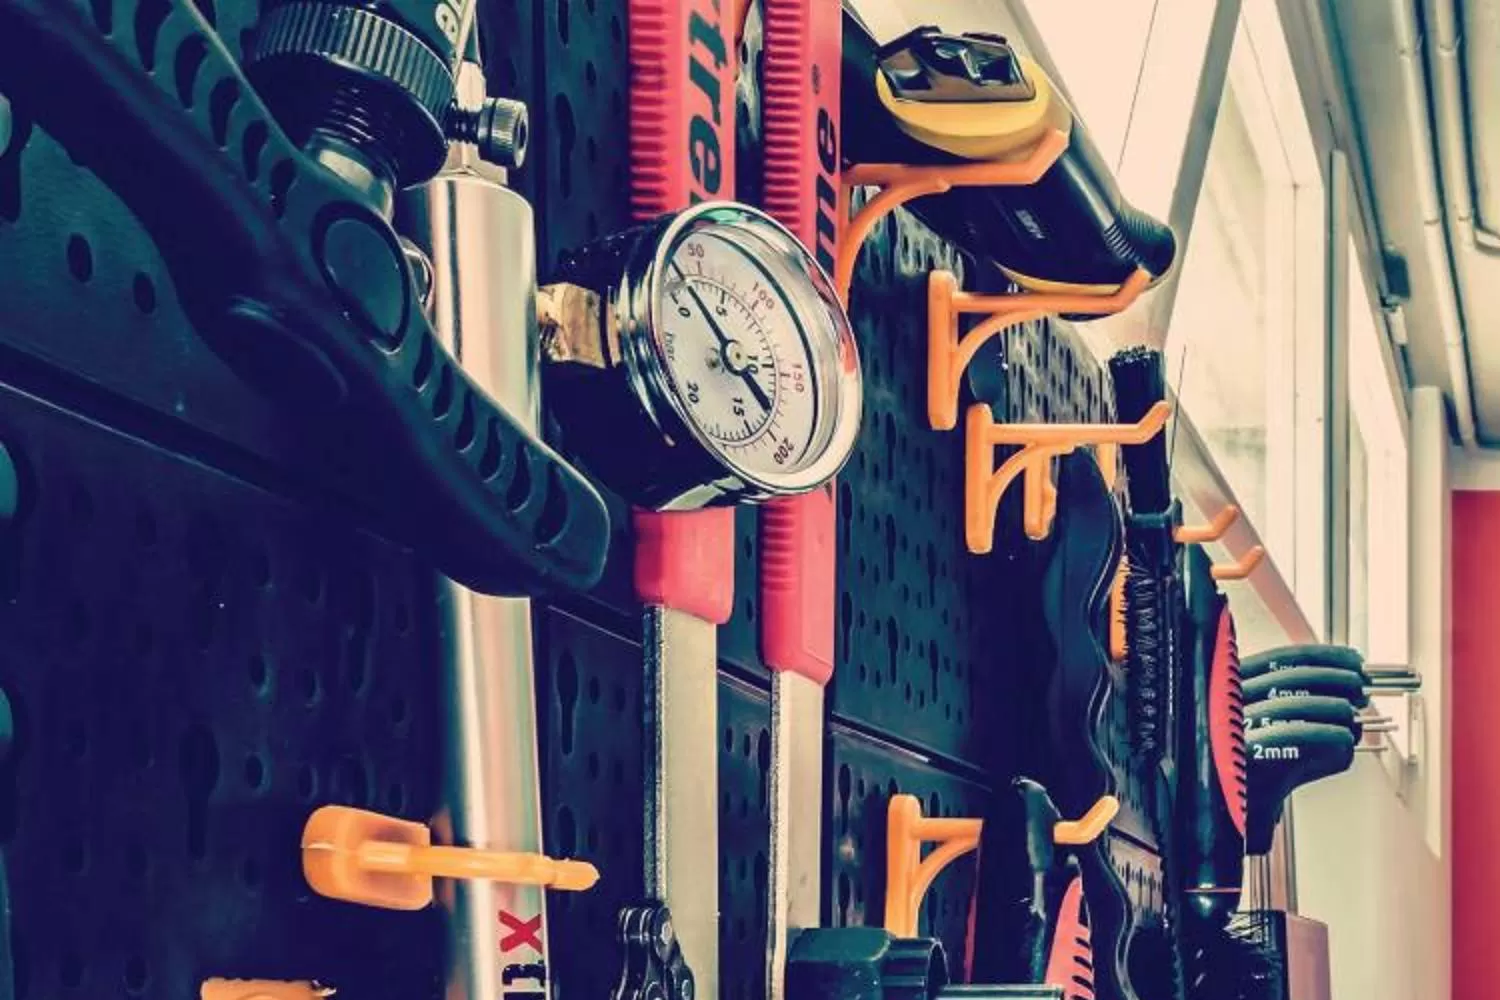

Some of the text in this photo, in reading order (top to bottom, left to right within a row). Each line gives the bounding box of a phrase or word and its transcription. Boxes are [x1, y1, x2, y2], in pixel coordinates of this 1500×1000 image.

[687, 243, 705, 258] 50
[677, 306, 691, 318] 0
[715, 306, 728, 318] 5
[687, 380, 701, 405] 20
[732, 397, 746, 418] 15
[1253, 743, 1300, 760] 2mm
